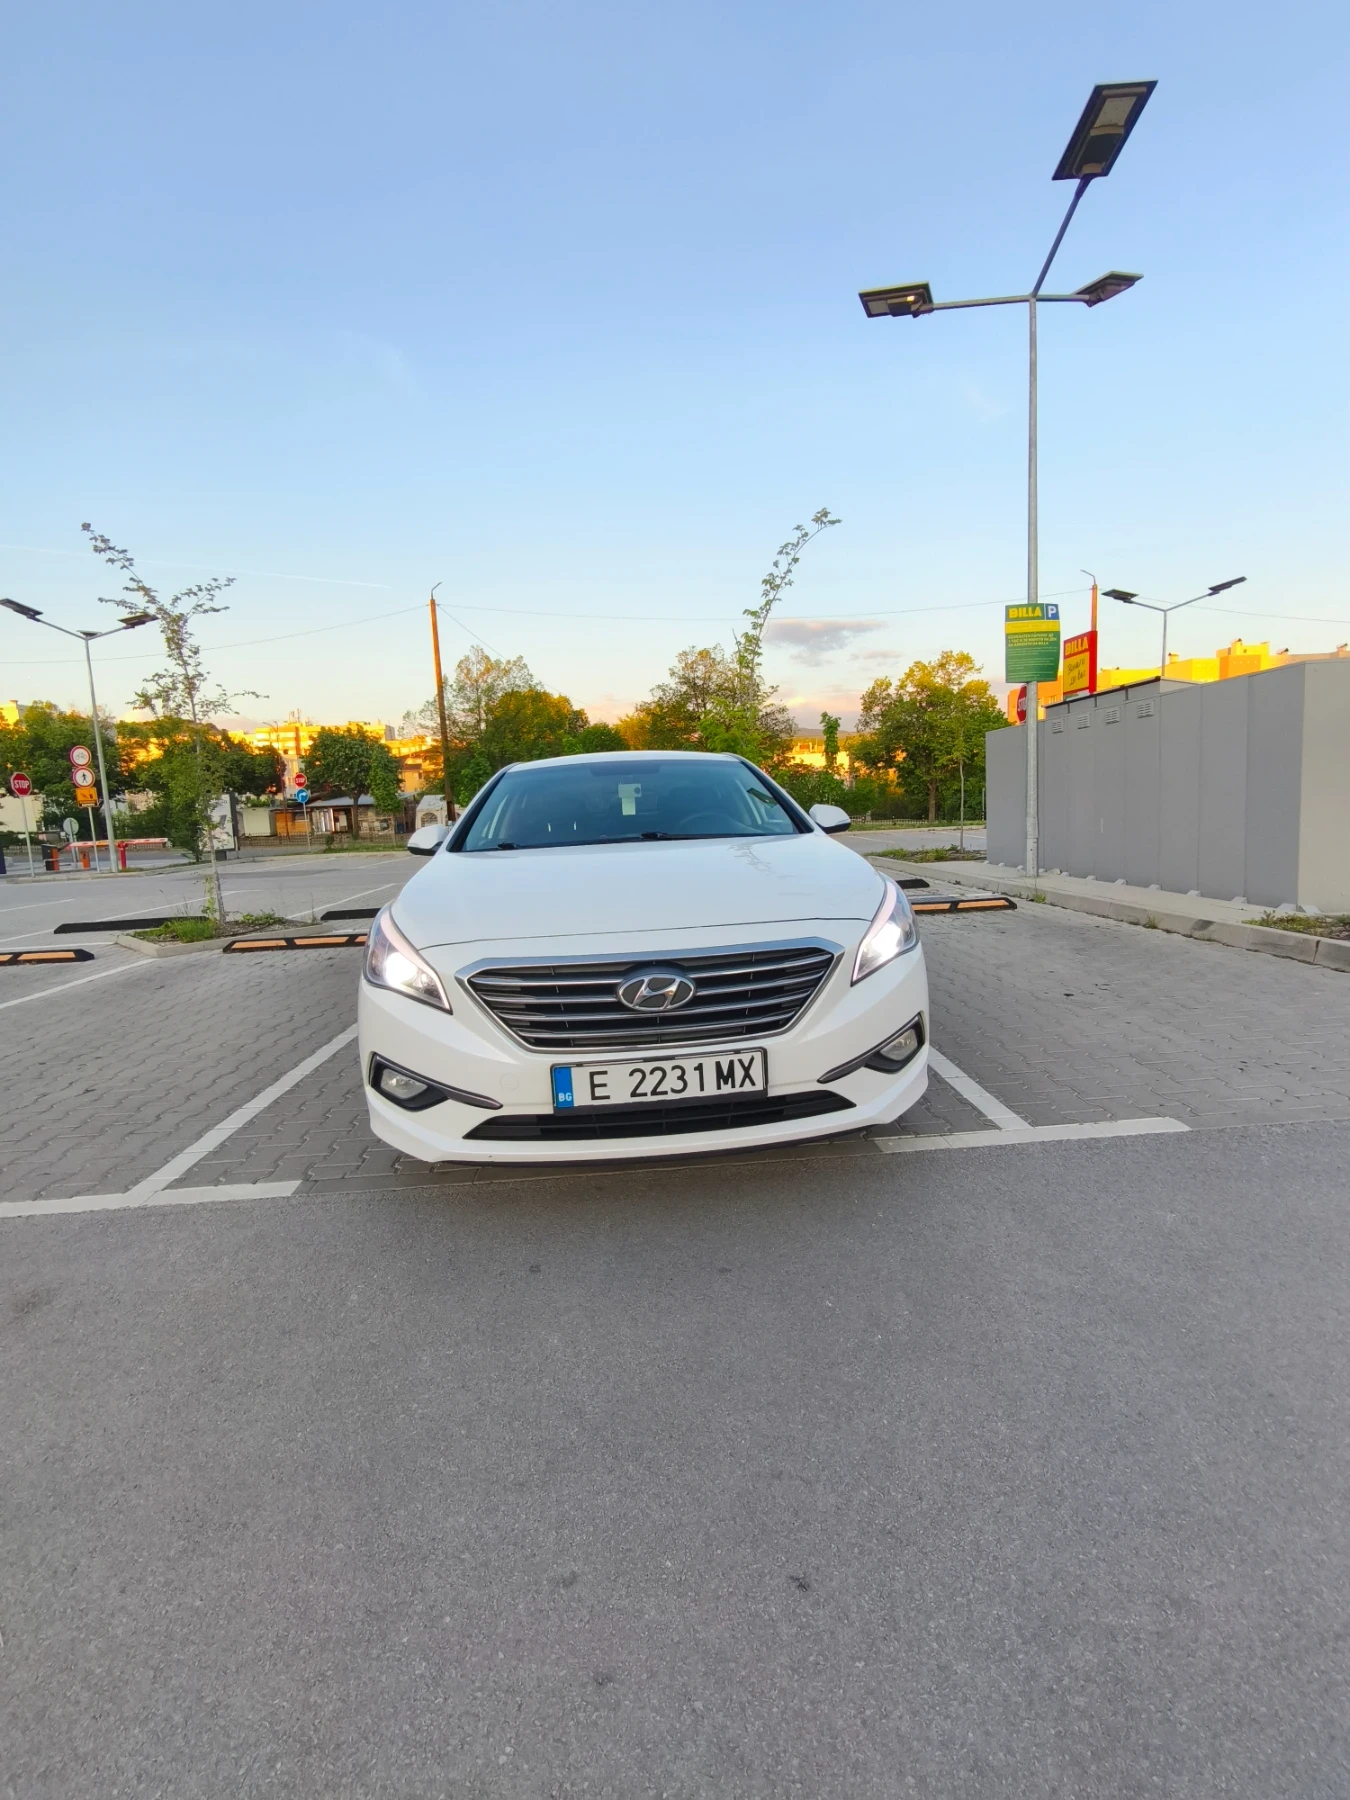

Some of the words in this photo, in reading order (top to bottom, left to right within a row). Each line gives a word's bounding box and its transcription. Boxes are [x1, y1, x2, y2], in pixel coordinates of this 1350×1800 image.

[1009, 607, 1042, 618] BILLA
[1048, 605, 1057, 618] P
[1065, 636, 1088, 656] BILLA
[14, 779, 30, 789] STOP
[589, 1070, 611, 1101] E
[628, 1061, 705, 1098] 2231
[715, 1055, 756, 1091] MX
[558, 1092, 573, 1102] BG
